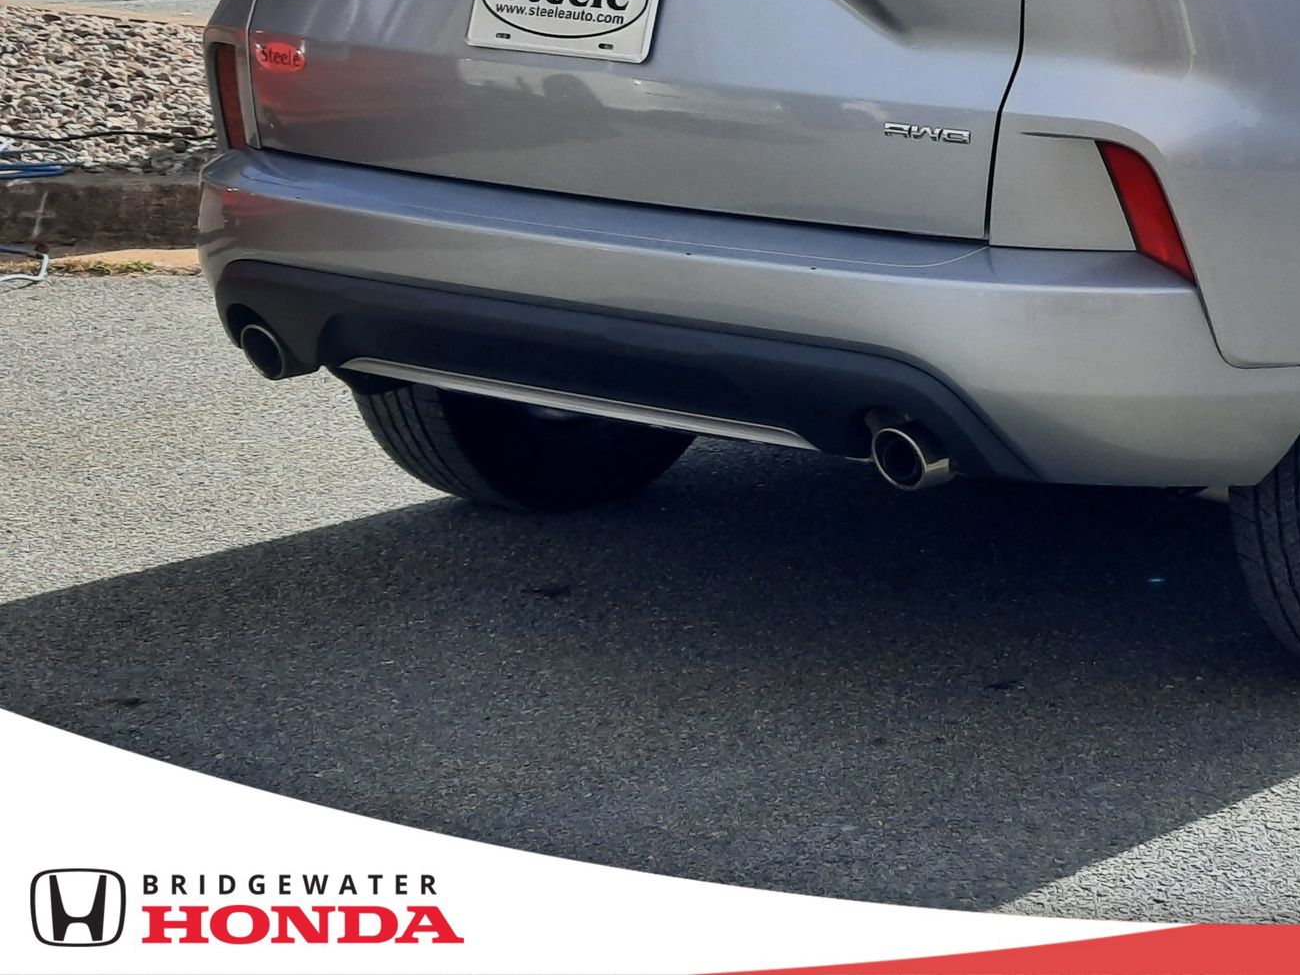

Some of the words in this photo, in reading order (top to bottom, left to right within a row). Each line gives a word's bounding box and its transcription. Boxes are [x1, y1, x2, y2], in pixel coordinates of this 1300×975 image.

[495, 2, 625, 24] www.steeleauto.com
[260, 46, 300, 67] Steele
[883, 121, 971, 145] AWD
